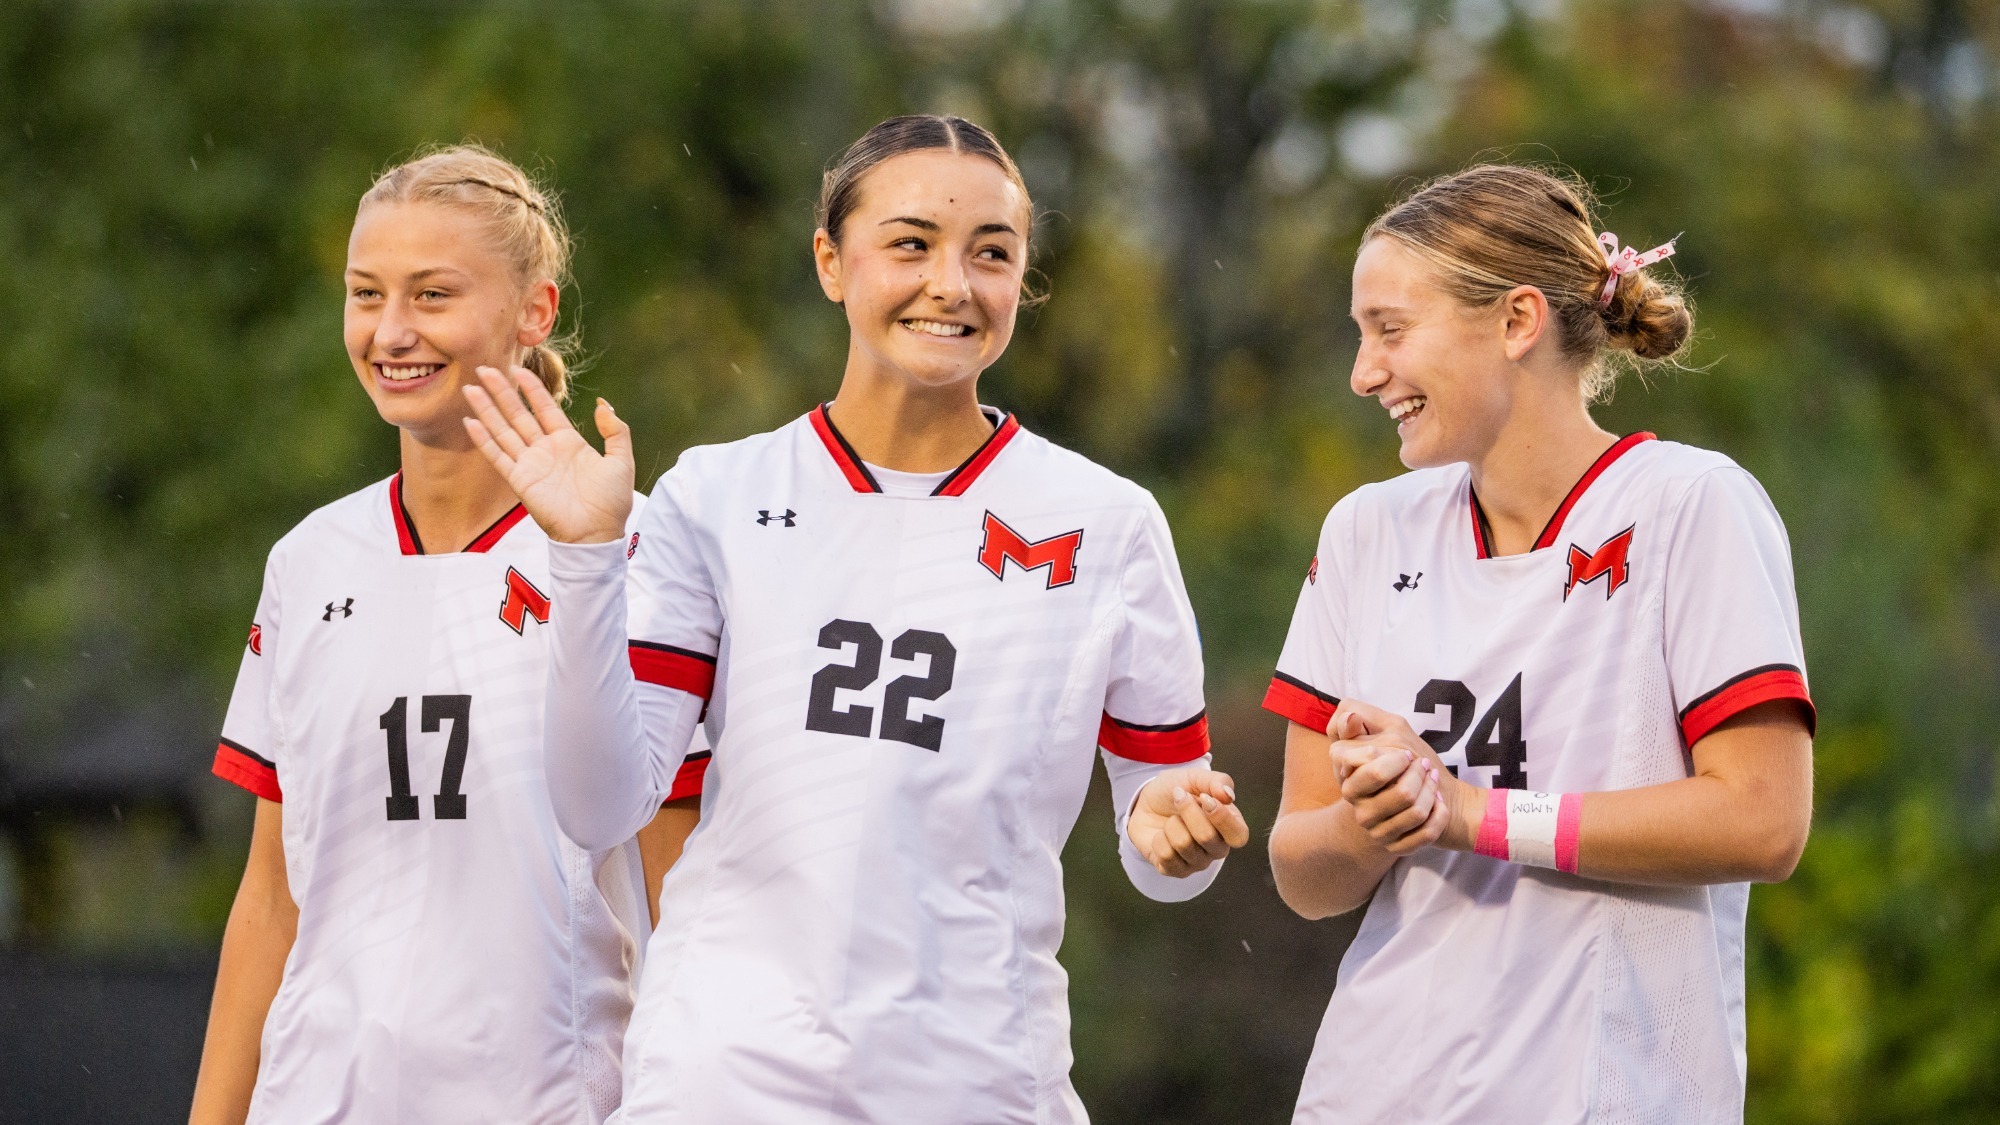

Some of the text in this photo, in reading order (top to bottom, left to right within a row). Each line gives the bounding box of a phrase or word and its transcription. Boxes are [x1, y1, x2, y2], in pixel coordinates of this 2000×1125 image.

[977, 508, 1084, 590] M
[1563, 521, 1637, 603] M
[805, 618, 957, 752] 22
[1414, 671, 1528, 790] 24
[379, 694, 472, 821] 17
[1512, 803, 1542, 814] MOM
